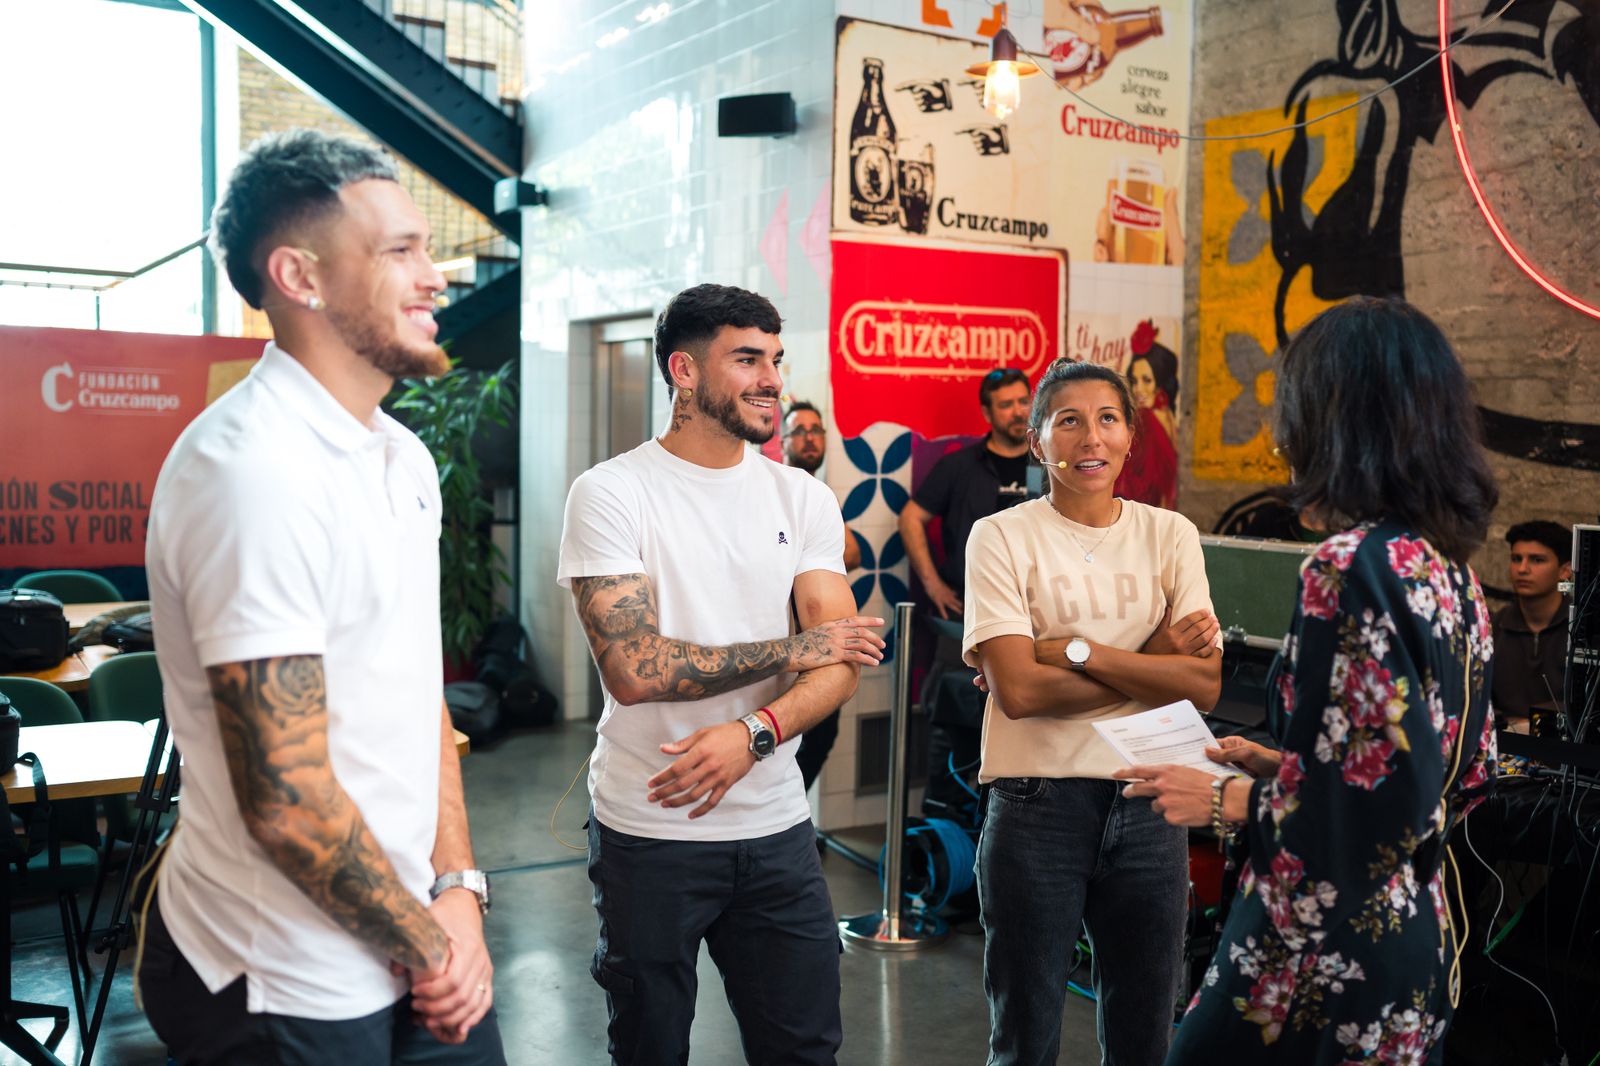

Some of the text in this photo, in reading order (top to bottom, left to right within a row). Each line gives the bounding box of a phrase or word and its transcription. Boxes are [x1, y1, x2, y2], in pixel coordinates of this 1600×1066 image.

[1121, 77, 1162, 99] alegre
[1135, 100, 1168, 117] sabor
[1060, 103, 1181, 155] Cruzcampo
[936, 196, 1049, 242] Cruzcampo
[854, 313, 1036, 367] Cruzcampo
[78, 388, 181, 412] Cruzcampo
[66, 515, 79, 544] Y
[88, 515, 133, 544] POR
